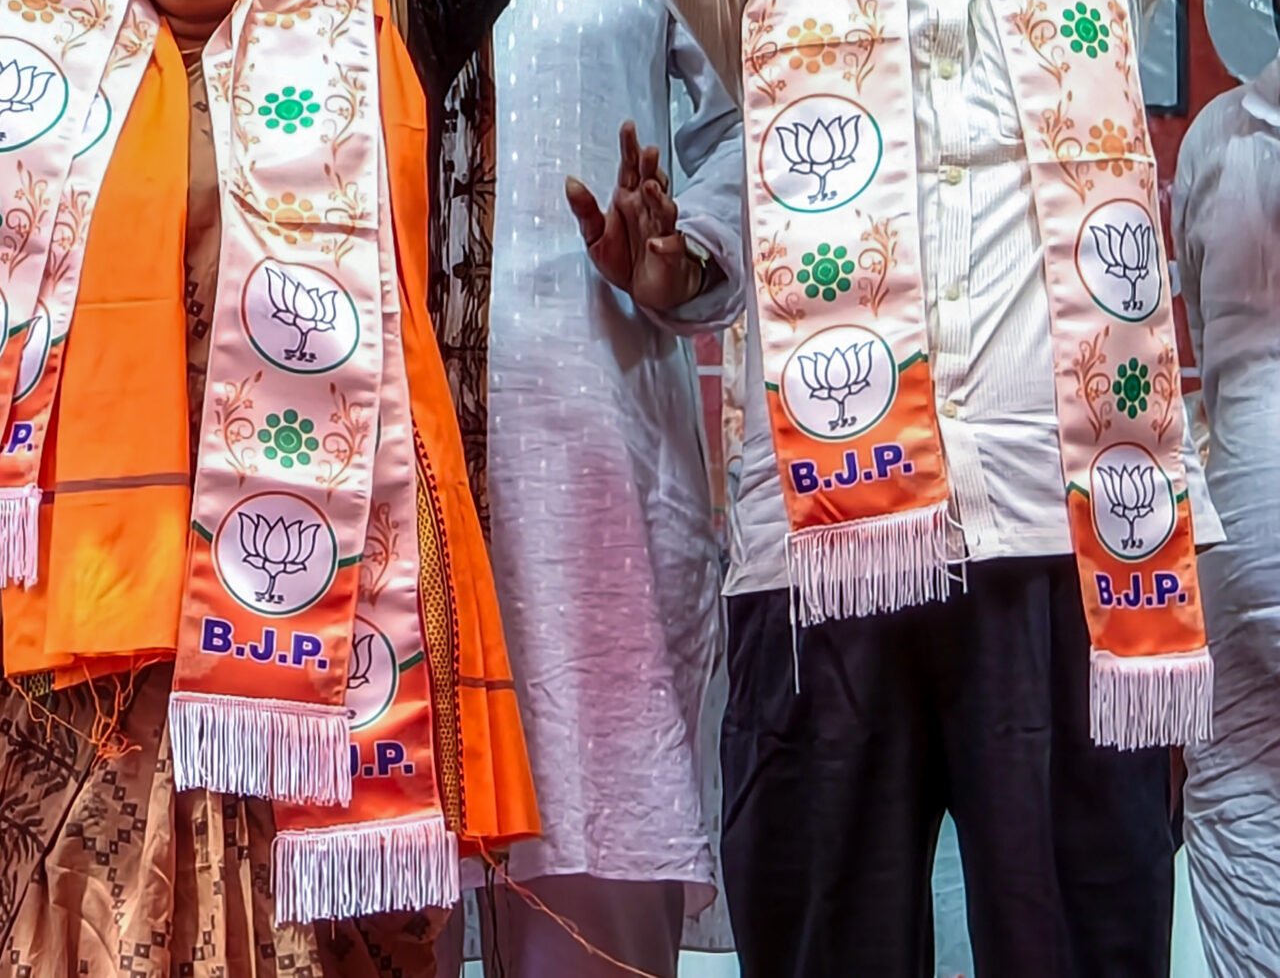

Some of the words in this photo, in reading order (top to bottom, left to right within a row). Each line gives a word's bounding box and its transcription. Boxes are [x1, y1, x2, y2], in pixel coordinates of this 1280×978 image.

[790, 444, 914, 494] B.J.P.
[1095, 572, 1187, 607] B.J.P.
[201, 618, 329, 670] B.J.P.
